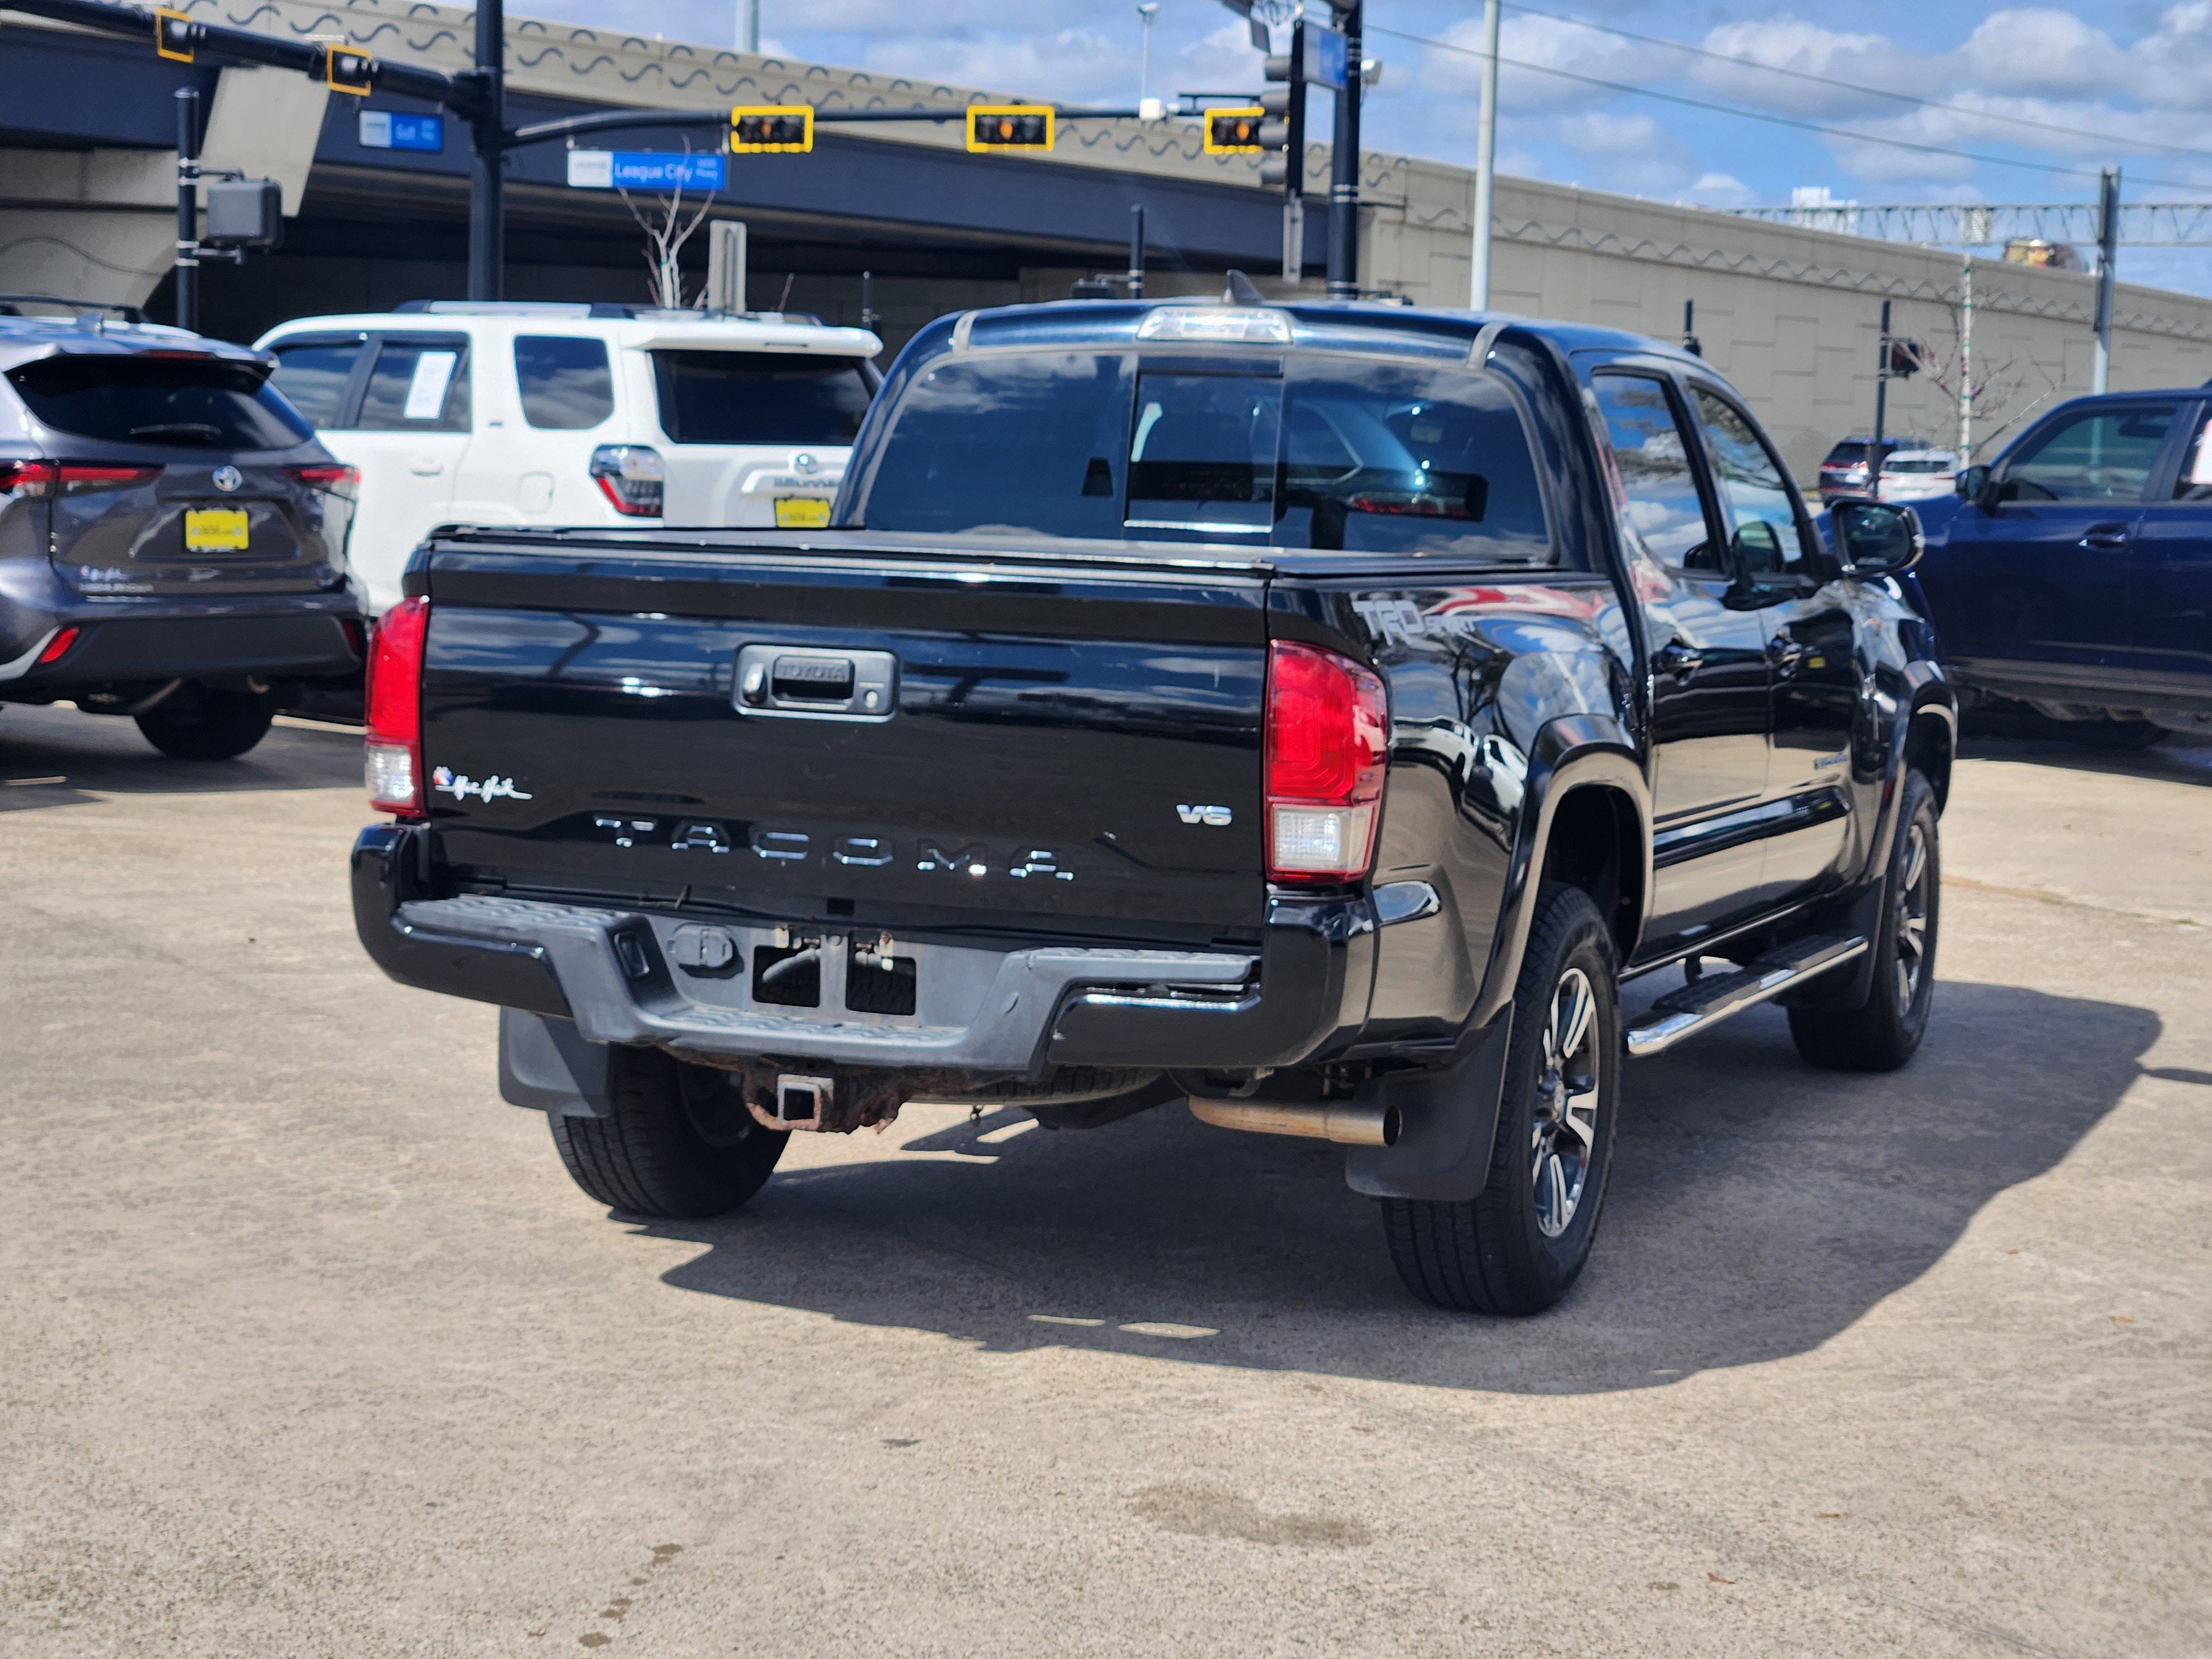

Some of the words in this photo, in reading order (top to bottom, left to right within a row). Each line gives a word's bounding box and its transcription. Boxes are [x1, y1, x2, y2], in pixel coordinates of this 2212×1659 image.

[1353, 600, 1425, 646] TRD
[779, 665, 847, 680] TOYOTA
[1176, 804, 1232, 826] V6
[593, 813, 1075, 882] TACOMA
